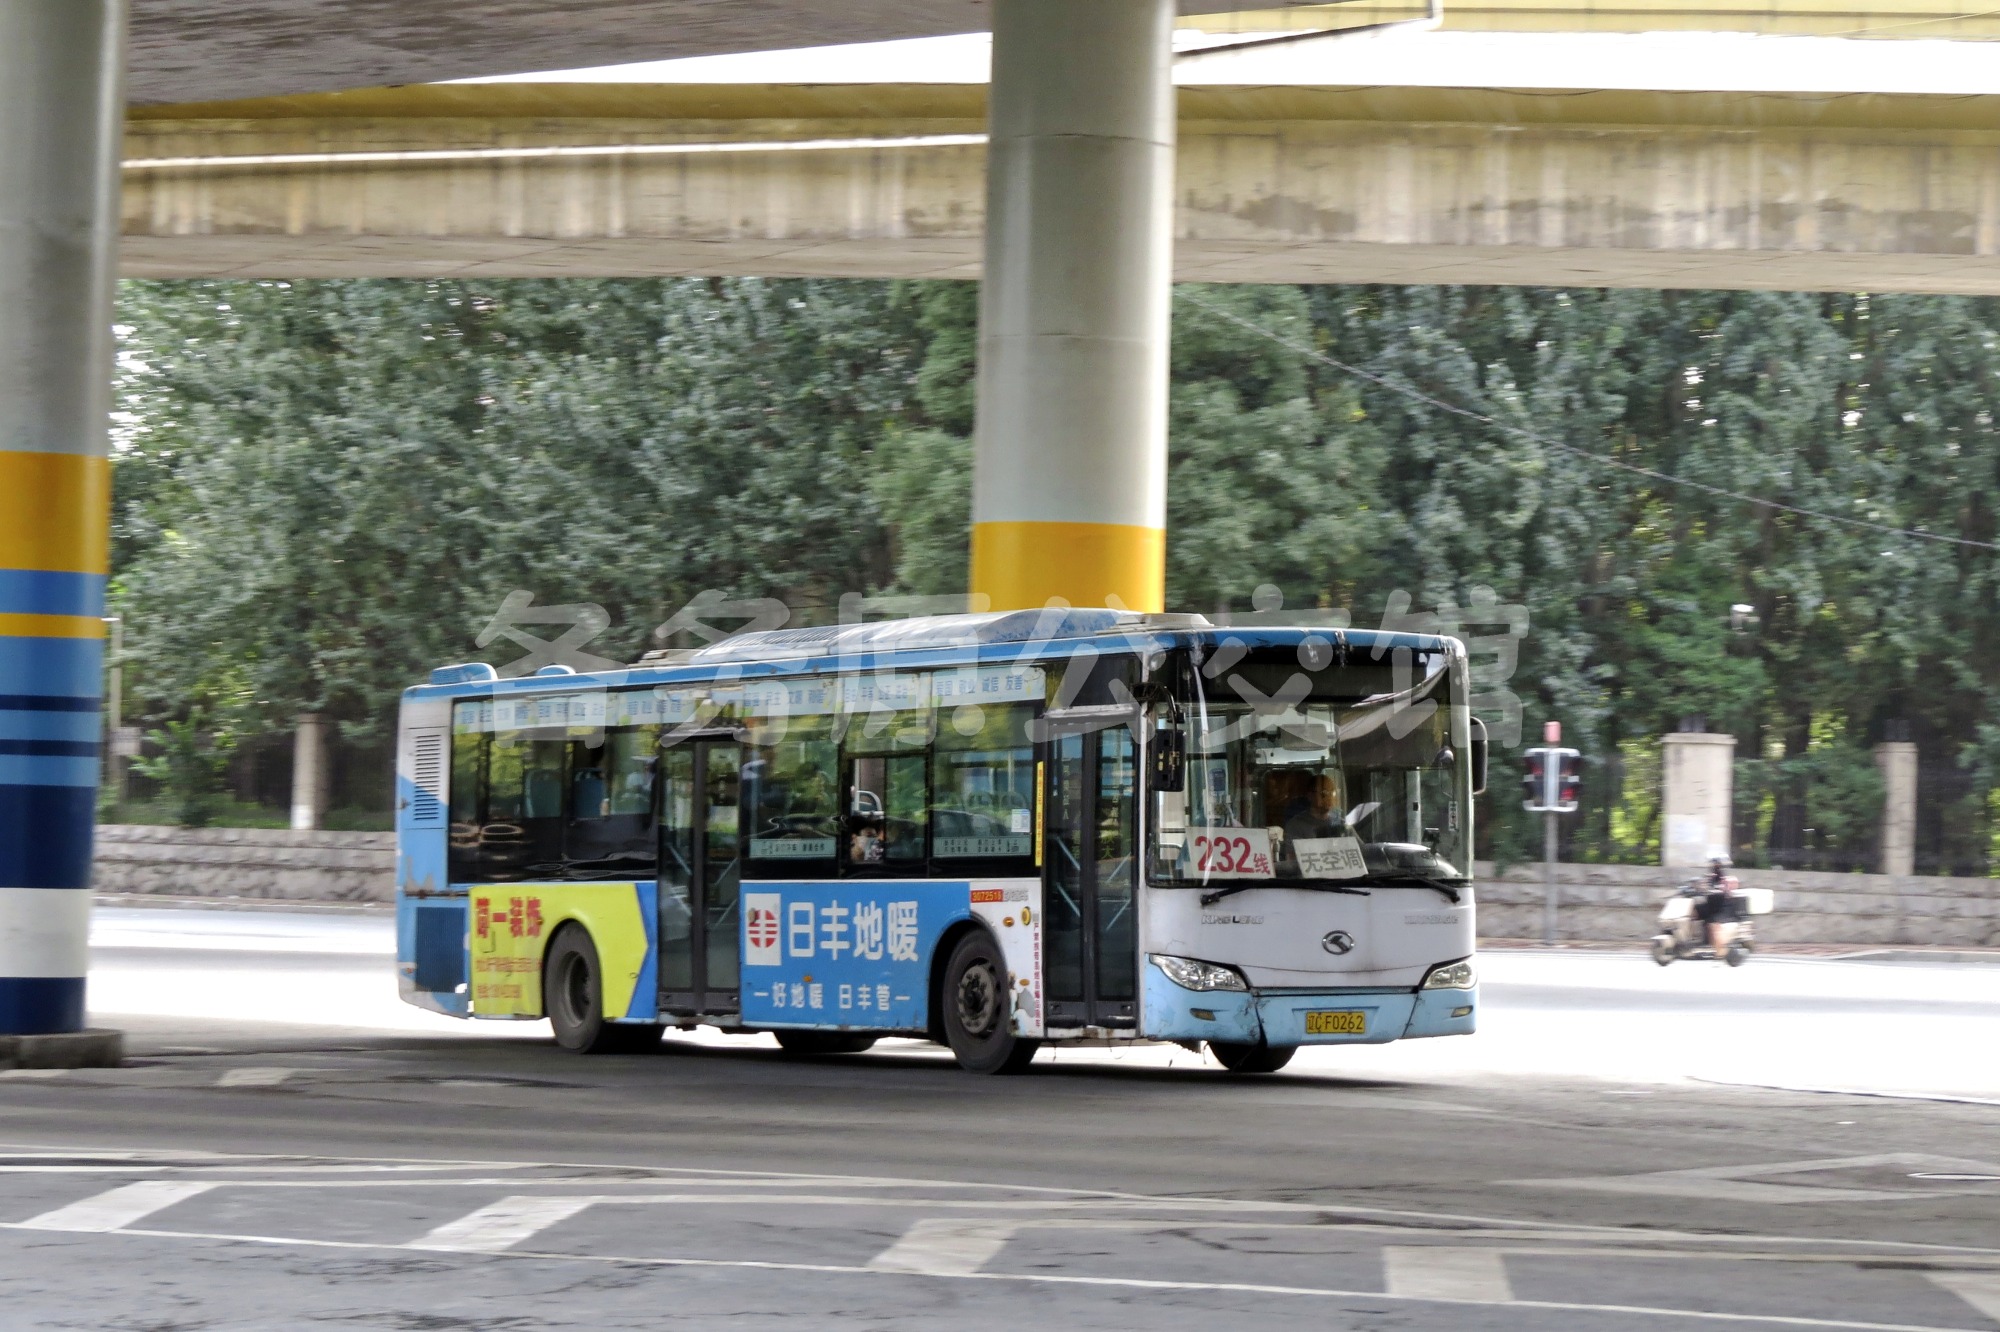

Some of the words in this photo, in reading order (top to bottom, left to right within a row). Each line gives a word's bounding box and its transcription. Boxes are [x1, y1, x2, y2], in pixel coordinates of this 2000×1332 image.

[1005, 674, 1023, 690] 友善
[1195, 836, 1270, 875] 232线
[1301, 848, 1363, 873] 无空调
[789, 899, 919, 962] 日丰地暖
